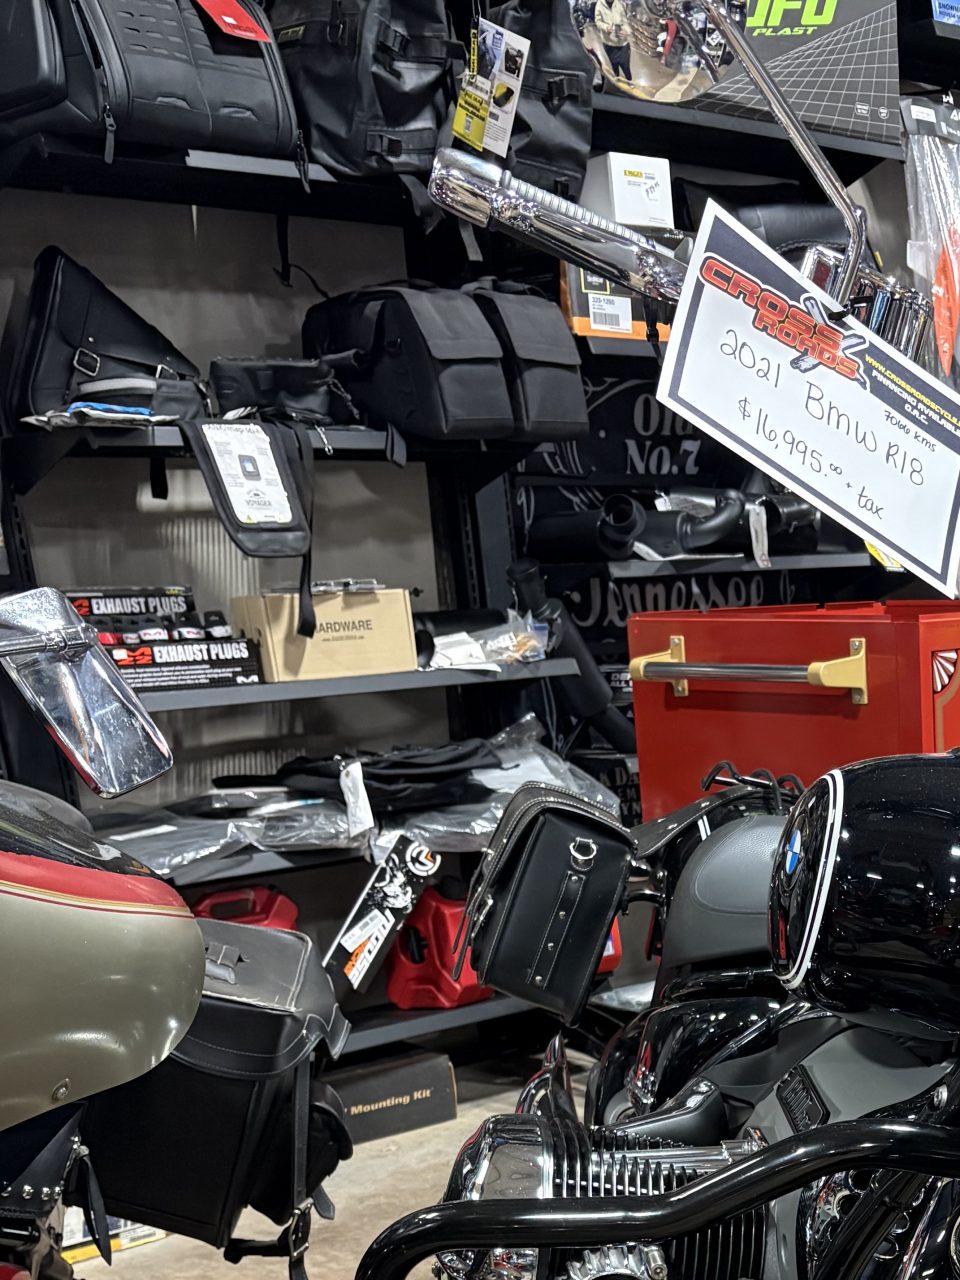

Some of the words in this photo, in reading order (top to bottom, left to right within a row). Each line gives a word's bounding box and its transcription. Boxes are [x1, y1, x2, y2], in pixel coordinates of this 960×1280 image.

[752, 26, 818, 37] PLAST
[702, 258, 845, 354] CROSS
[754, 310, 859, 380] ROADS
[871, 369, 917, 407] FINANCING
[720, 328, 781, 389] 2021
[885, 441, 925, 487] R18
[856, 485, 886, 520] tax
[91, 599, 146, 615] EXHAUST
[150, 597, 187, 616] PLUGS
[315, 619, 373, 634] ARDWARE
[155, 645, 209, 663] EXHAUST
[210, 643, 249, 659] PLUGS
[350, 1094, 411, 1116] Mounting
[413, 1088, 432, 1101] Kit
